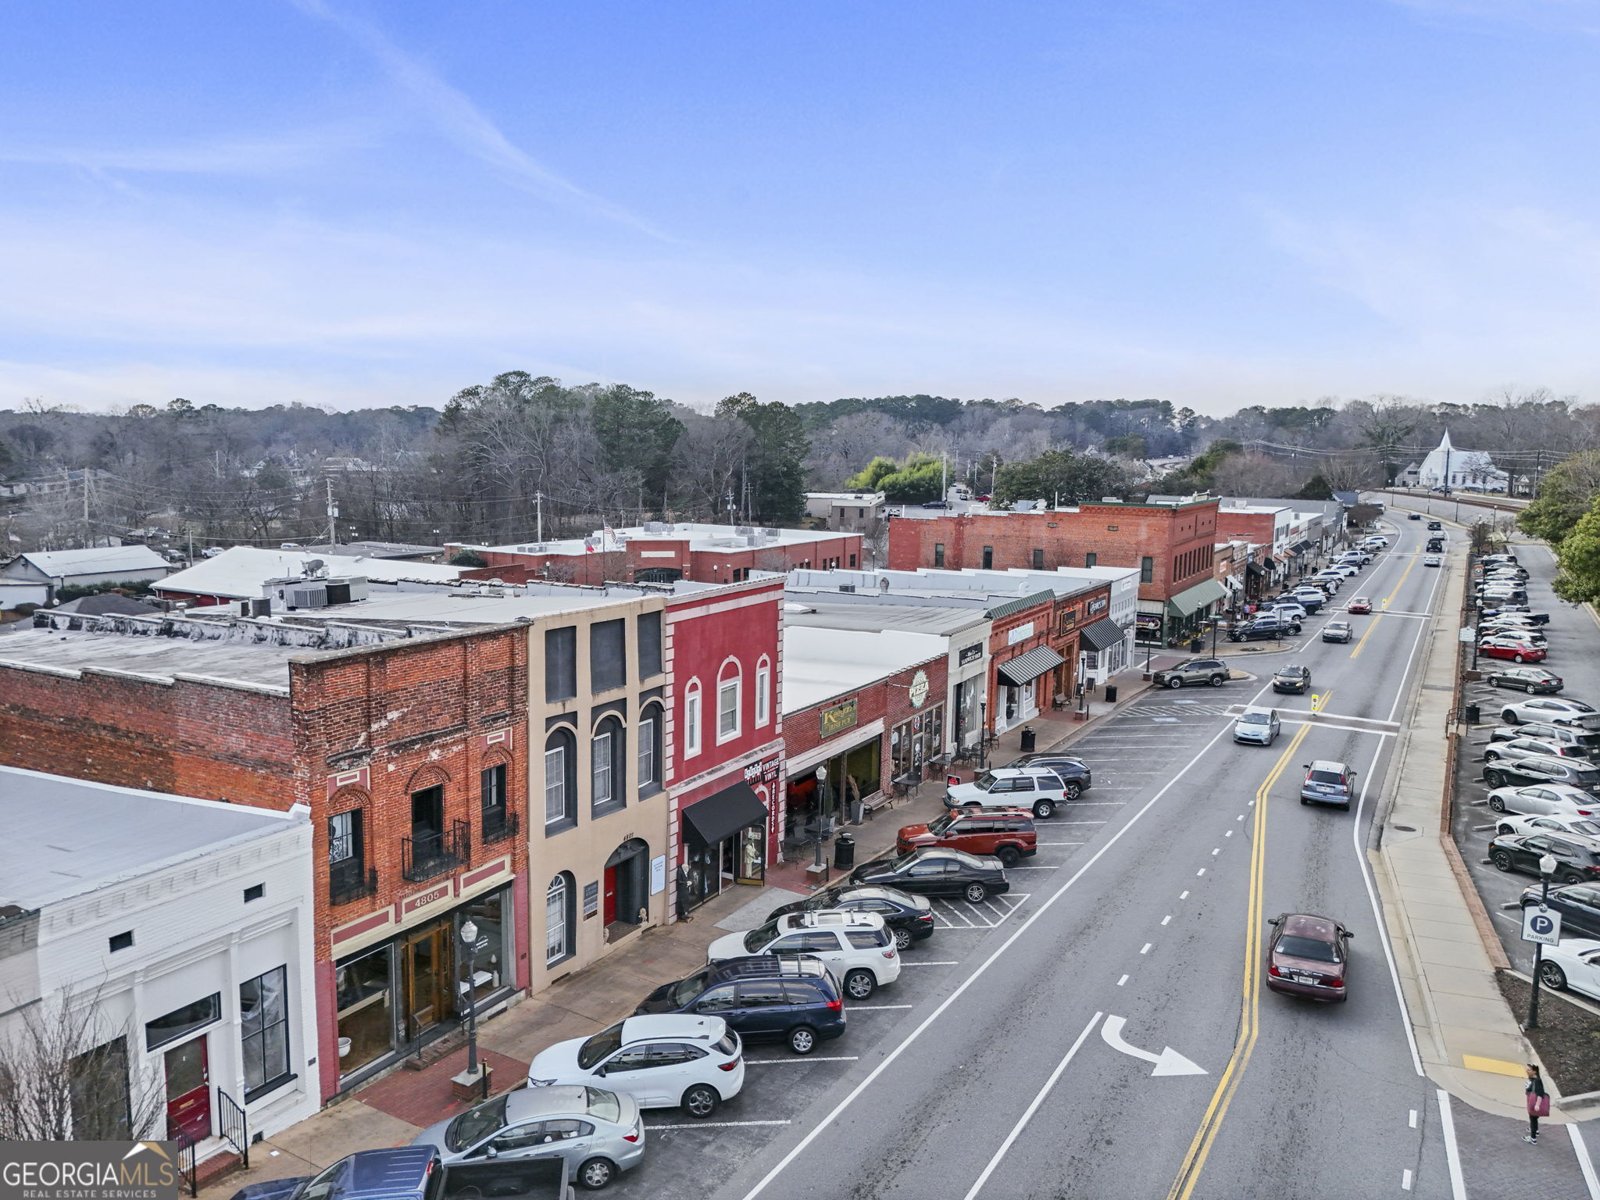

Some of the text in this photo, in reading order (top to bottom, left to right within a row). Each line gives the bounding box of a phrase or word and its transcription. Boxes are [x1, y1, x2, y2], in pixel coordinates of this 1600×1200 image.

[909, 681, 929, 699] PIZZA
[762, 757, 779, 771] VINTAGE
[764, 770, 777, 782] VINYL
[414, 890, 440, 907] 4805
[1536, 917, 1549, 931] P
[1526, 933, 1554, 943] PARKING
